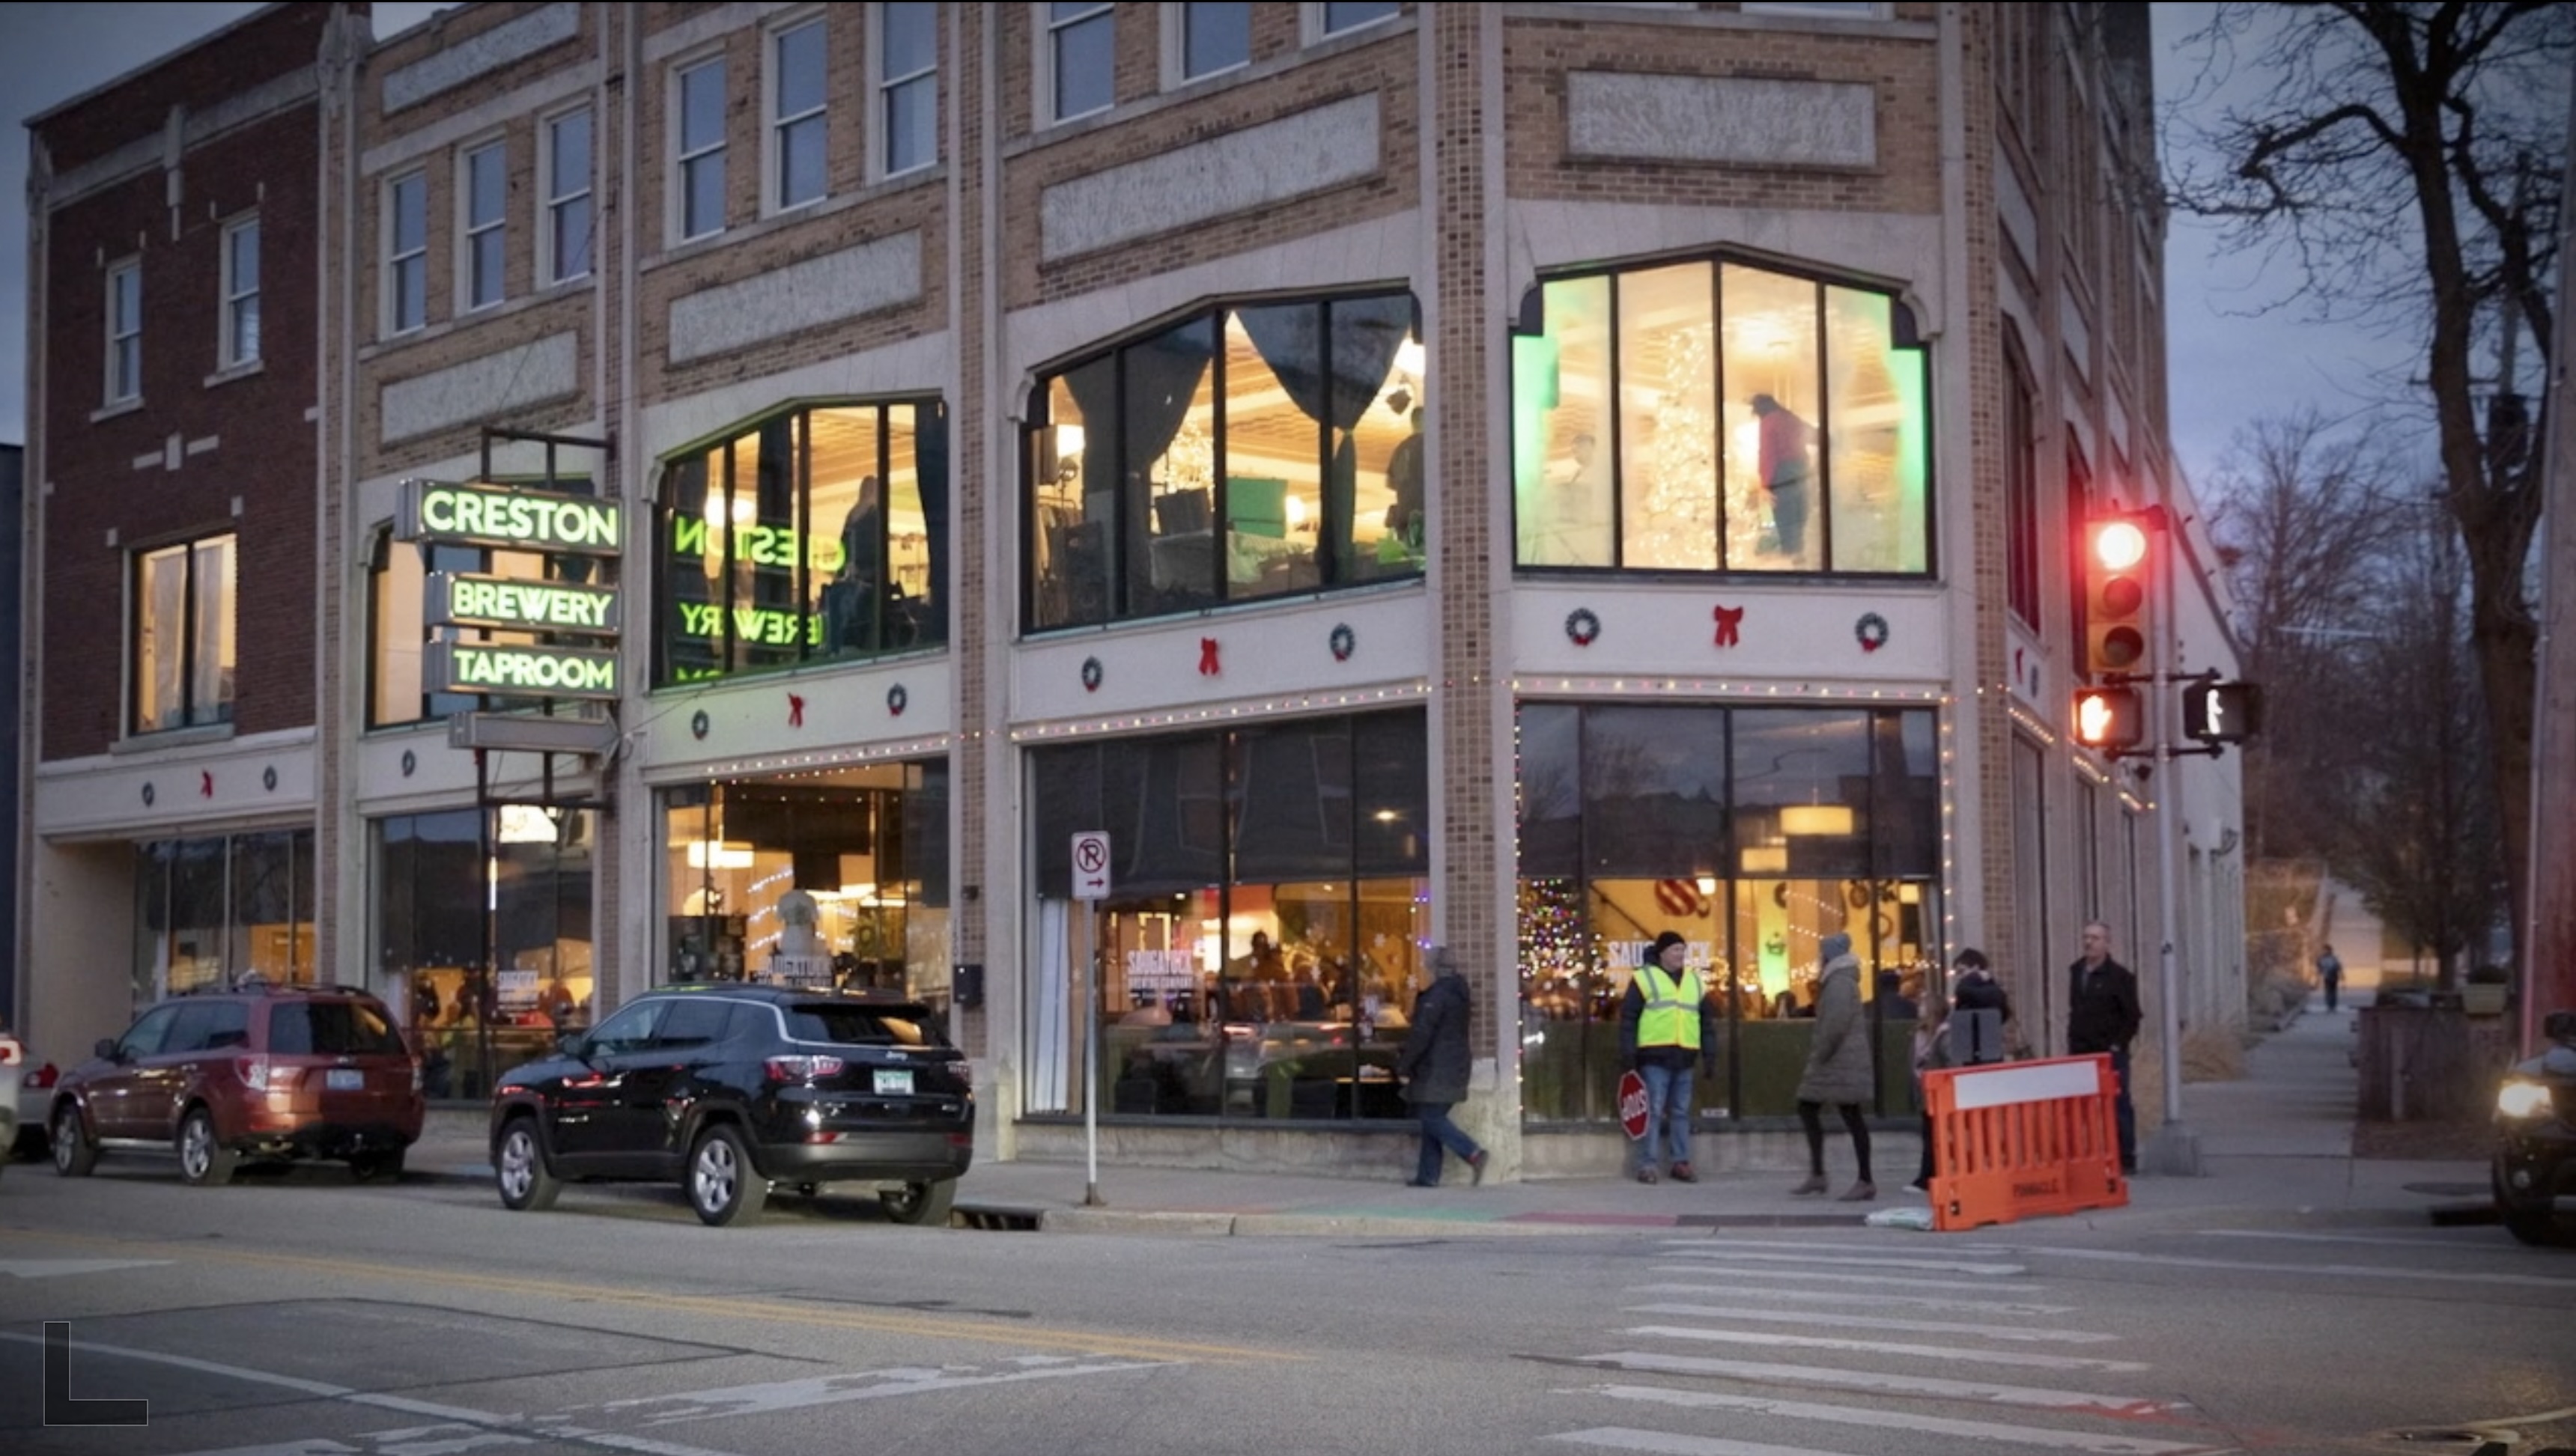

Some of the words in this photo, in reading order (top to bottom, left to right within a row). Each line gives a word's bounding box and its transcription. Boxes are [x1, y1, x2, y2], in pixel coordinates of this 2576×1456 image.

[423, 490, 618, 546] CRESTON
[454, 581, 612, 626] BREWERY
[453, 650, 613, 690] TAPROOM
[1623, 1088, 1647, 1121] STOP
